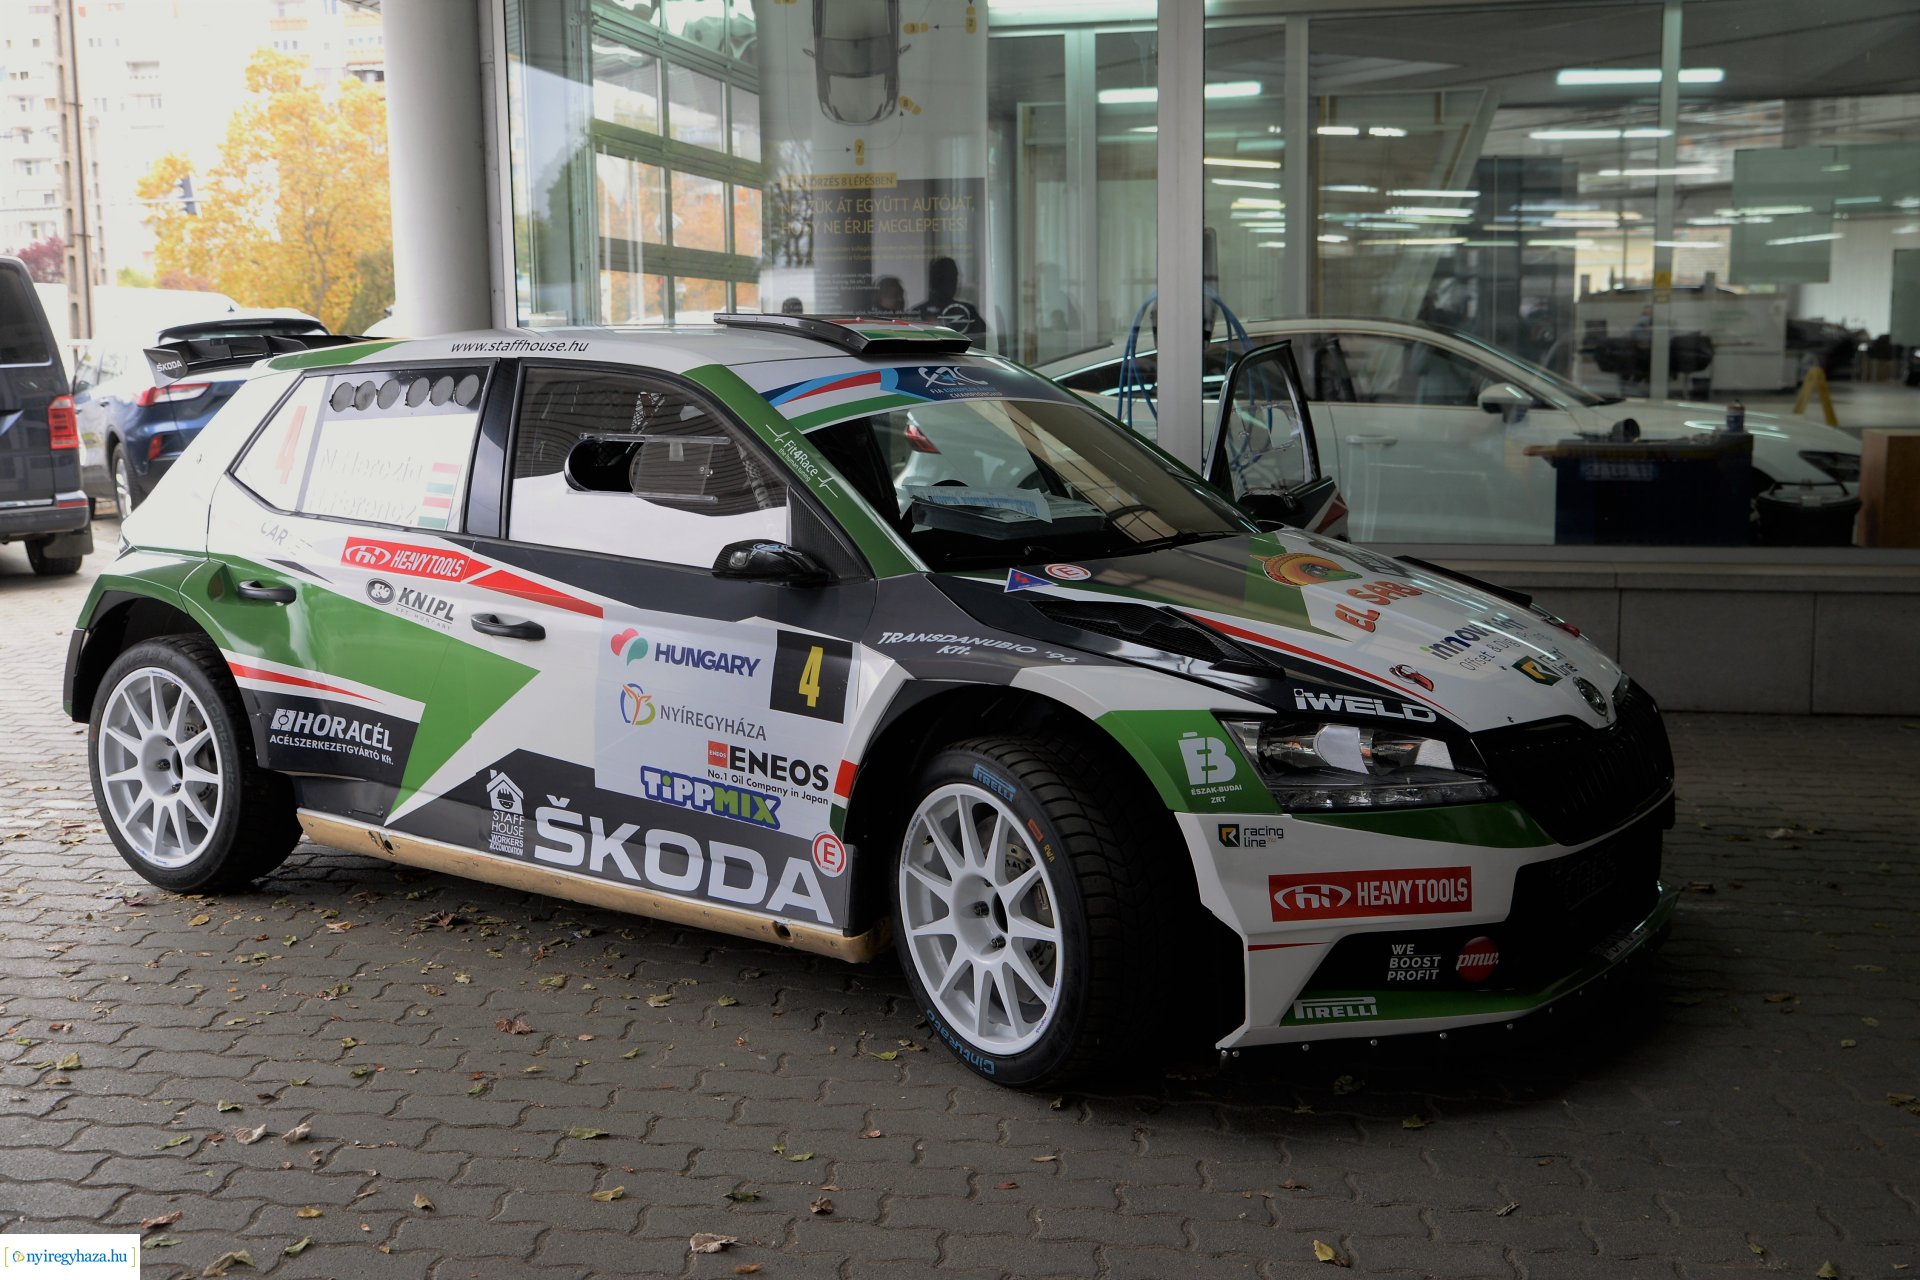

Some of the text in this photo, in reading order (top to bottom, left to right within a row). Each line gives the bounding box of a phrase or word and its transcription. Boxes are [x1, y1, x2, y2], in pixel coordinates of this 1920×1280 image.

[837, 197, 854, 213] ÁT
[824, 219, 841, 234] NE
[845, 217, 875, 233] ÉRJE
[451, 340, 590, 353] www.staffhouse.hu
[156, 360, 183, 372] ŠKODA
[783, 440, 818, 477] Fit4Race
[398, 587, 455, 621] KNIPL
[877, 631, 1080, 664] TRANSDANUBIO '96
[655, 642, 761, 677] HUNGARY
[798, 645, 824, 708] 4
[660, 704, 767, 741] NYÍREGYHÁZA
[293, 711, 393, 752] HORACÉL
[269, 734, 394, 765] ACÉLSZERKEZETGYÁRTÓ Kft.
[709, 749, 727, 758] ENEOS
[729, 745, 829, 791] ENEOS
[731, 774, 744, 785] Oil
[746, 778, 788, 797] Company
[790, 788, 799, 797] in
[801, 791, 829, 805] Japan
[972, 762, 1018, 803] PIRELLI
[1190, 784, 1243, 796] ÉSZAK-BUDAI
[1210, 796, 1226, 804] ZRT
[492, 810, 525, 826] STAFF
[491, 820, 525, 837] HOUSE
[1243, 825, 1284, 839] racing
[490, 833, 524, 848] WORKERS
[1243, 837, 1267, 848] line
[534, 794, 834, 924] ŠKODA
[823, 841, 836, 866] E
[1391, 944, 1415, 955] WE
[1389, 956, 1442, 969] BOOST
[1387, 969, 1440, 981] PROFIT
[1293, 996, 1378, 1019] PIRELLI
